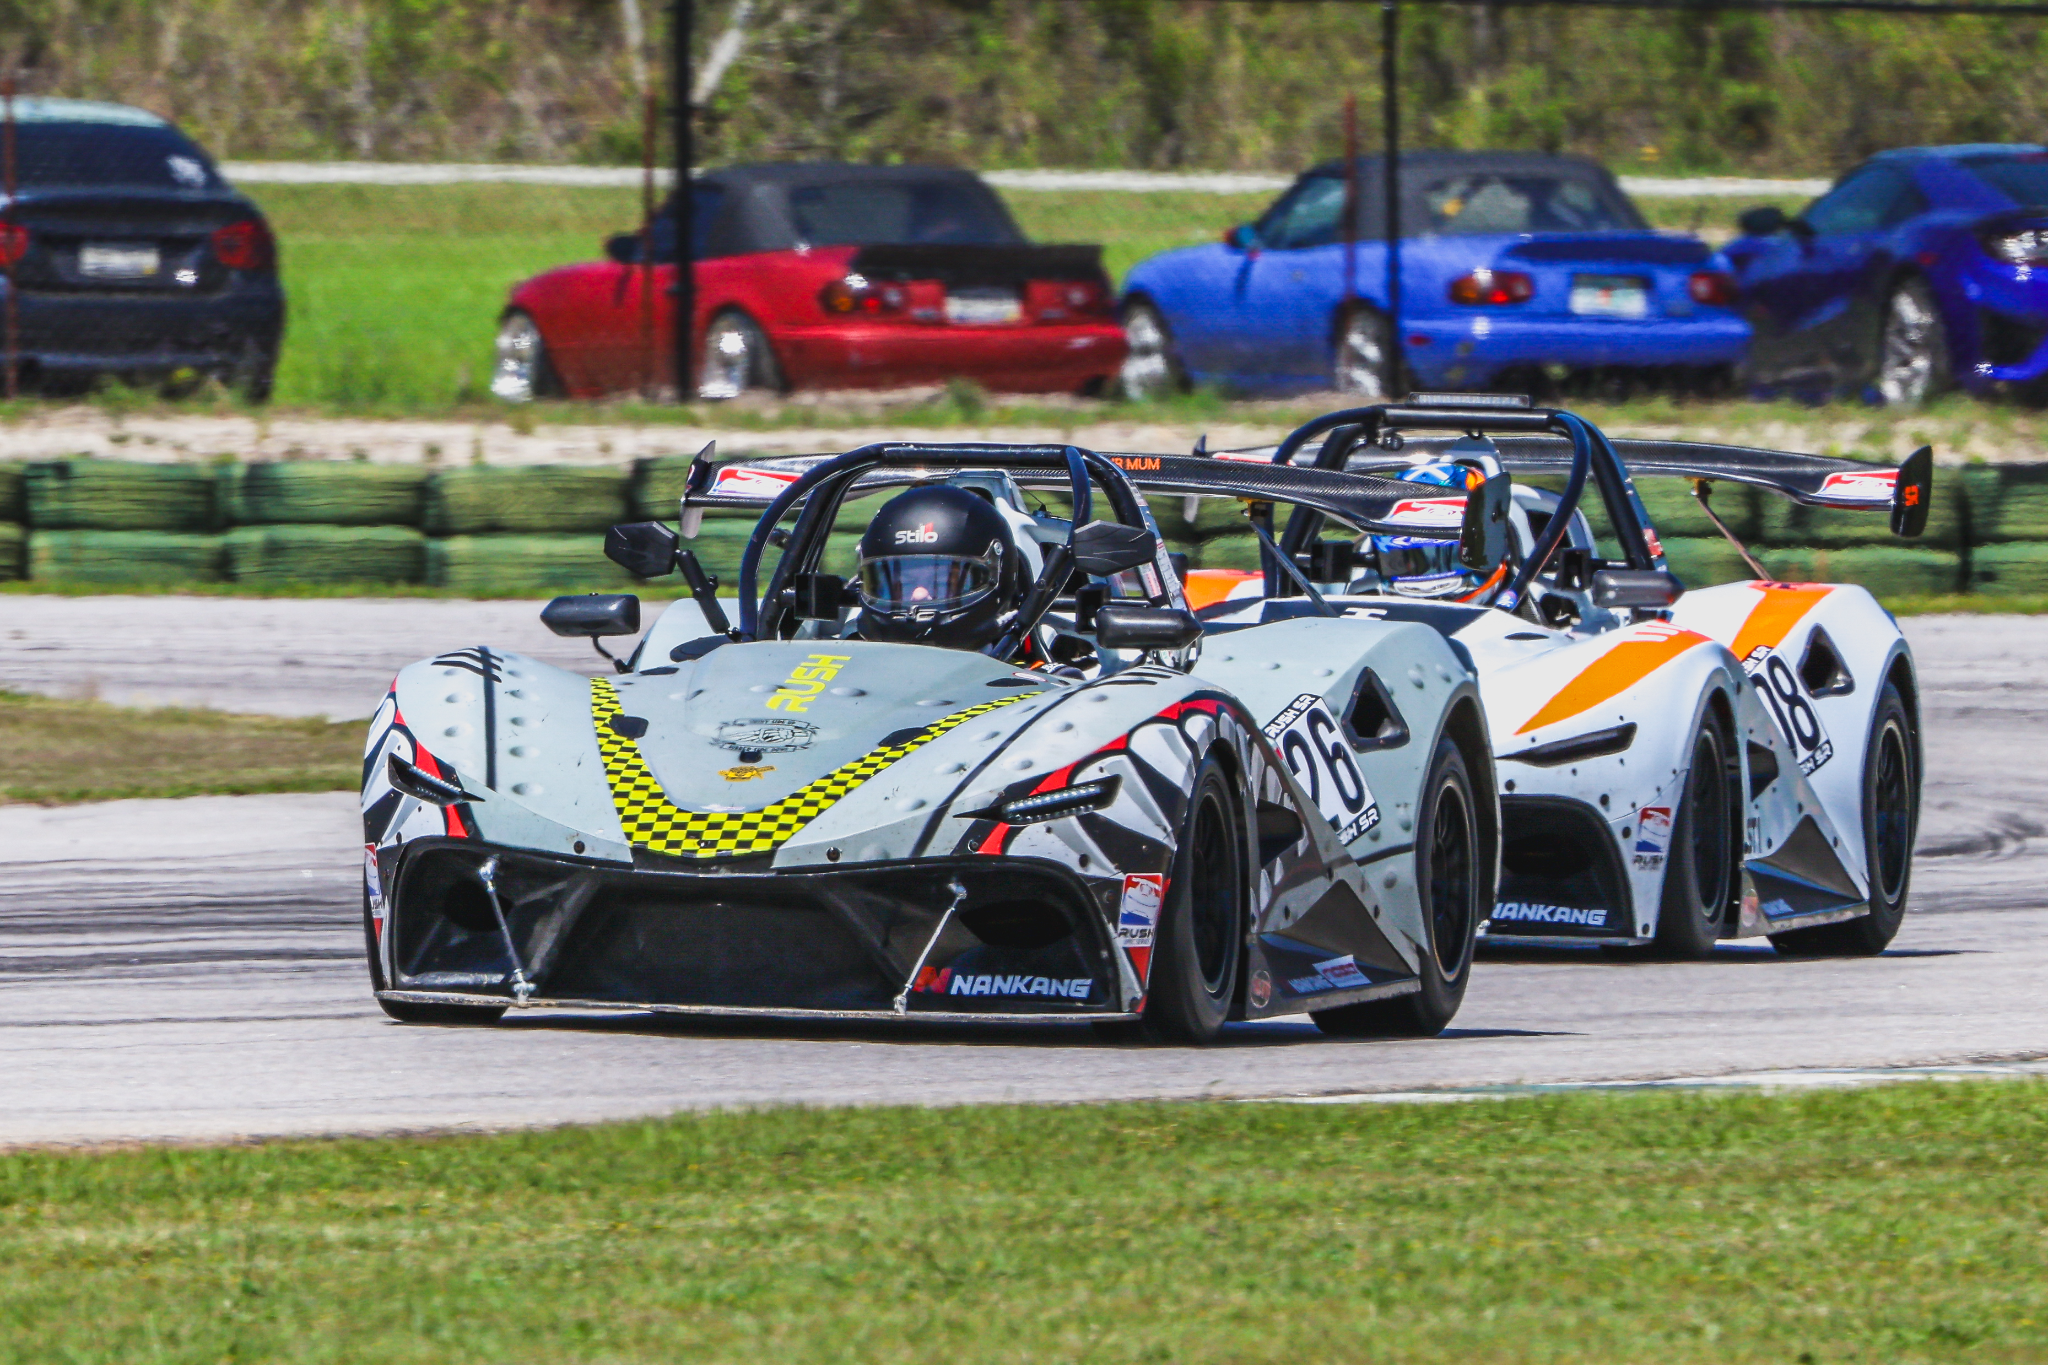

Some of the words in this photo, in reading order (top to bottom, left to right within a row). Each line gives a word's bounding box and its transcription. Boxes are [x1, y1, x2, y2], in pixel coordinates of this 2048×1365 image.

[1126, 457, 1161, 470] MUM
[894, 523, 939, 545] Stilo
[765, 654, 852, 712] RUSH
[1264, 708, 1300, 738] RUSH
[1296, 694, 1316, 714] SR
[1283, 707, 1365, 833] 26
[1359, 808, 1379, 832] SR
[1118, 927, 1155, 939] RUSH
[950, 974, 1093, 999] NANKANG
